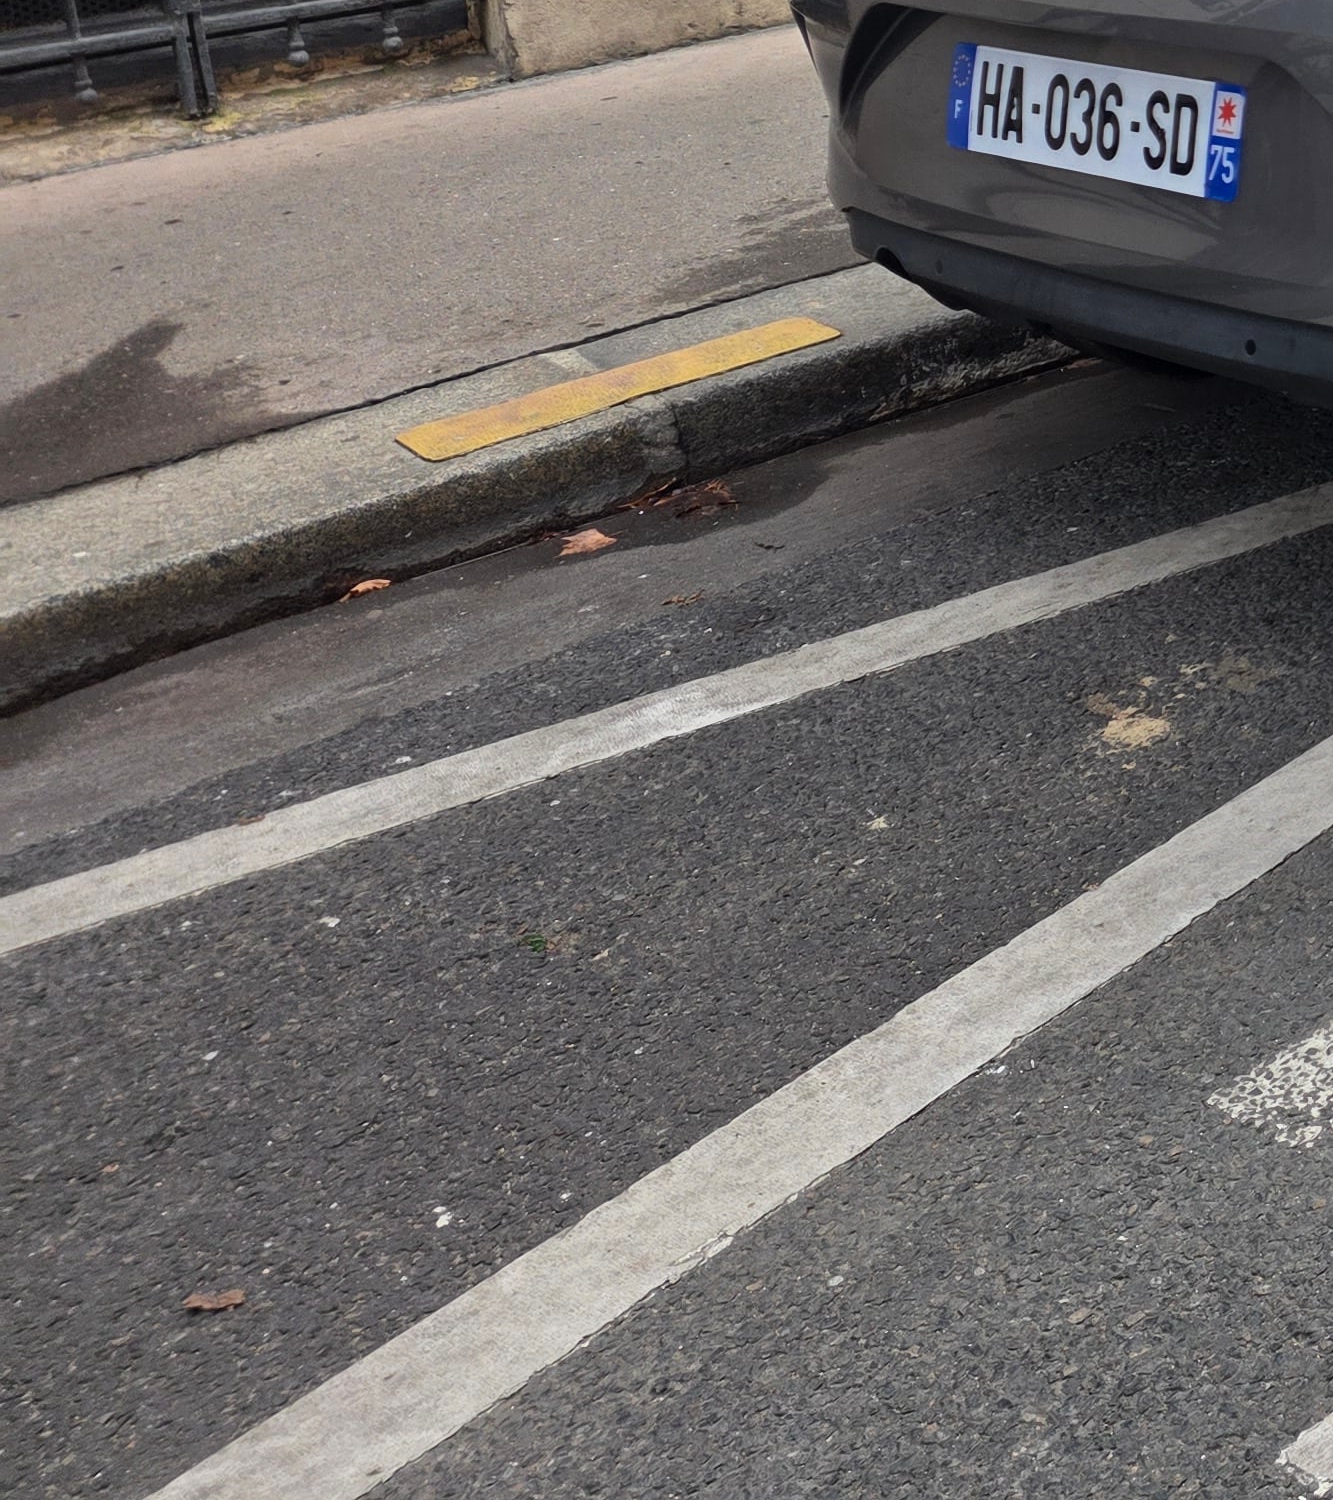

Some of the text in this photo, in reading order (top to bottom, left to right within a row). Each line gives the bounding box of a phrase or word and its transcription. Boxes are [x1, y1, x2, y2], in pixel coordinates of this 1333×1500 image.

[953, 99, 964, 119] F
[976, 60, 1199, 177] HA-036-SD
[1208, 144, 1235, 184] 75
